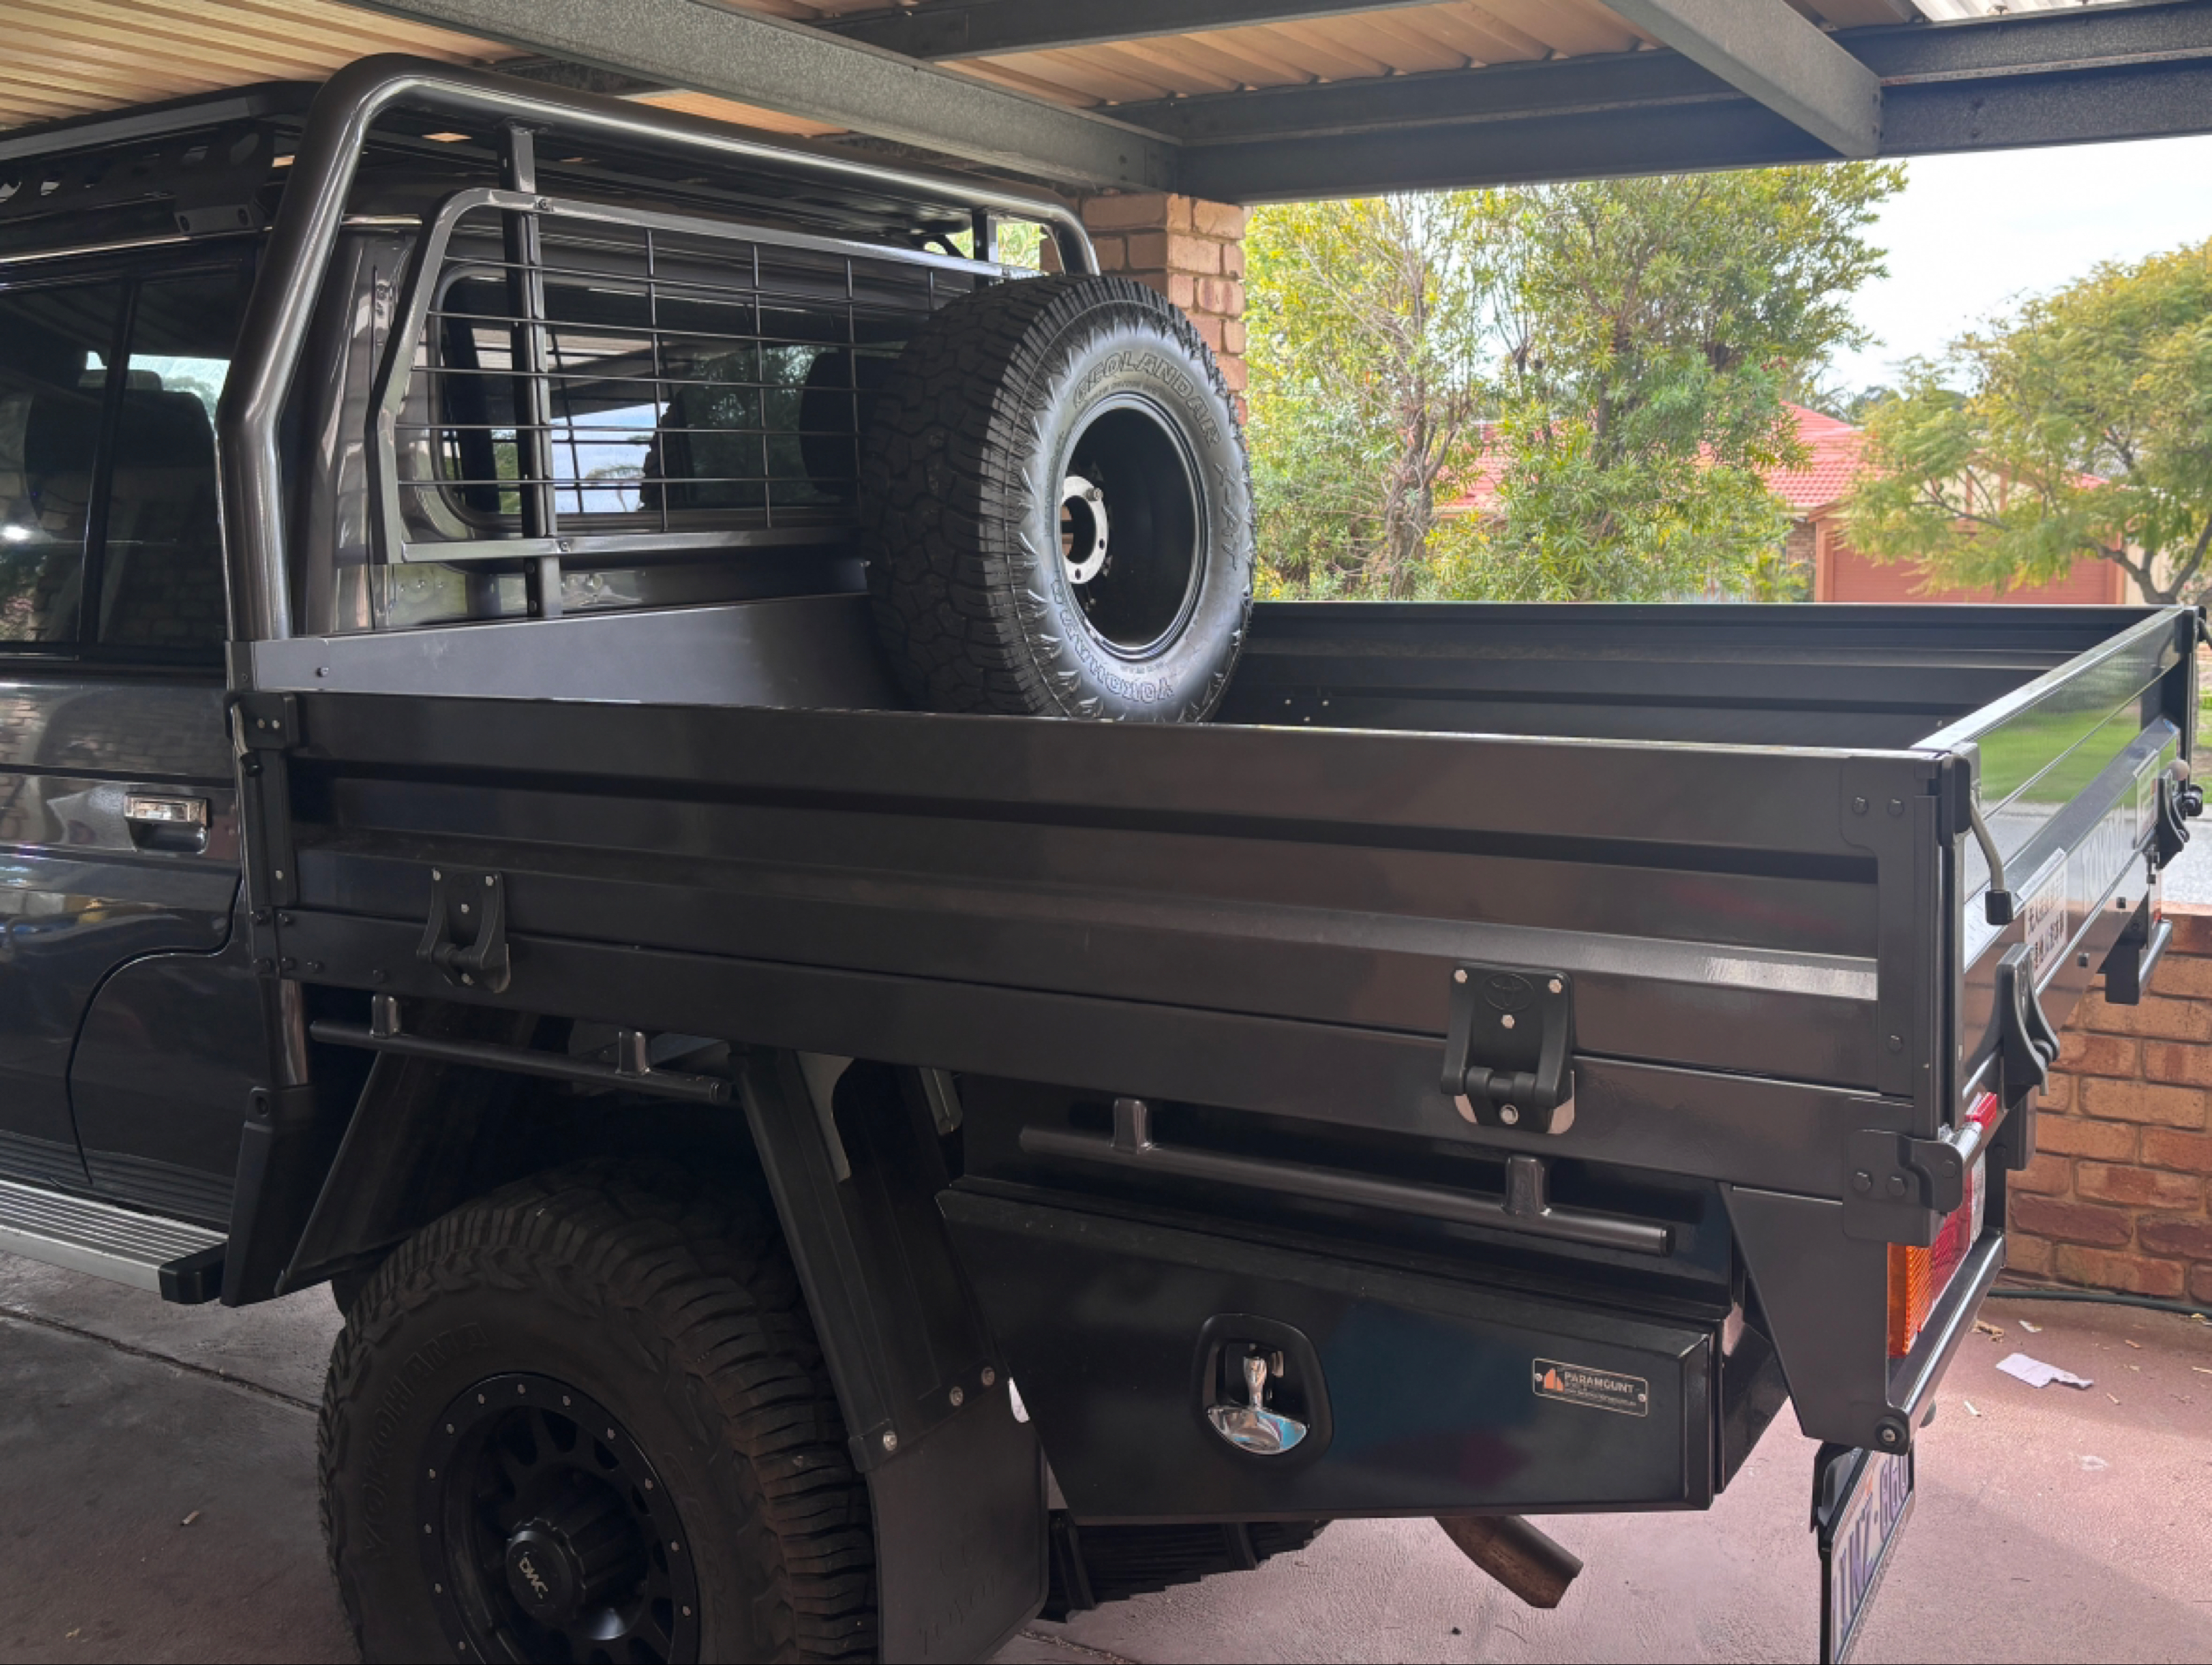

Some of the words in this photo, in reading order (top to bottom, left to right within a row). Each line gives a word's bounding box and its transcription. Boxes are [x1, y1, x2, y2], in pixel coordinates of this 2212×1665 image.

[1073, 350, 1222, 449] GEOLANDAR
[1051, 579, 1175, 704] YOKOHAMA
[1564, 1370, 1635, 1394] PARAMOUNT
[362, 1321, 489, 1560] YOKOHAMA
